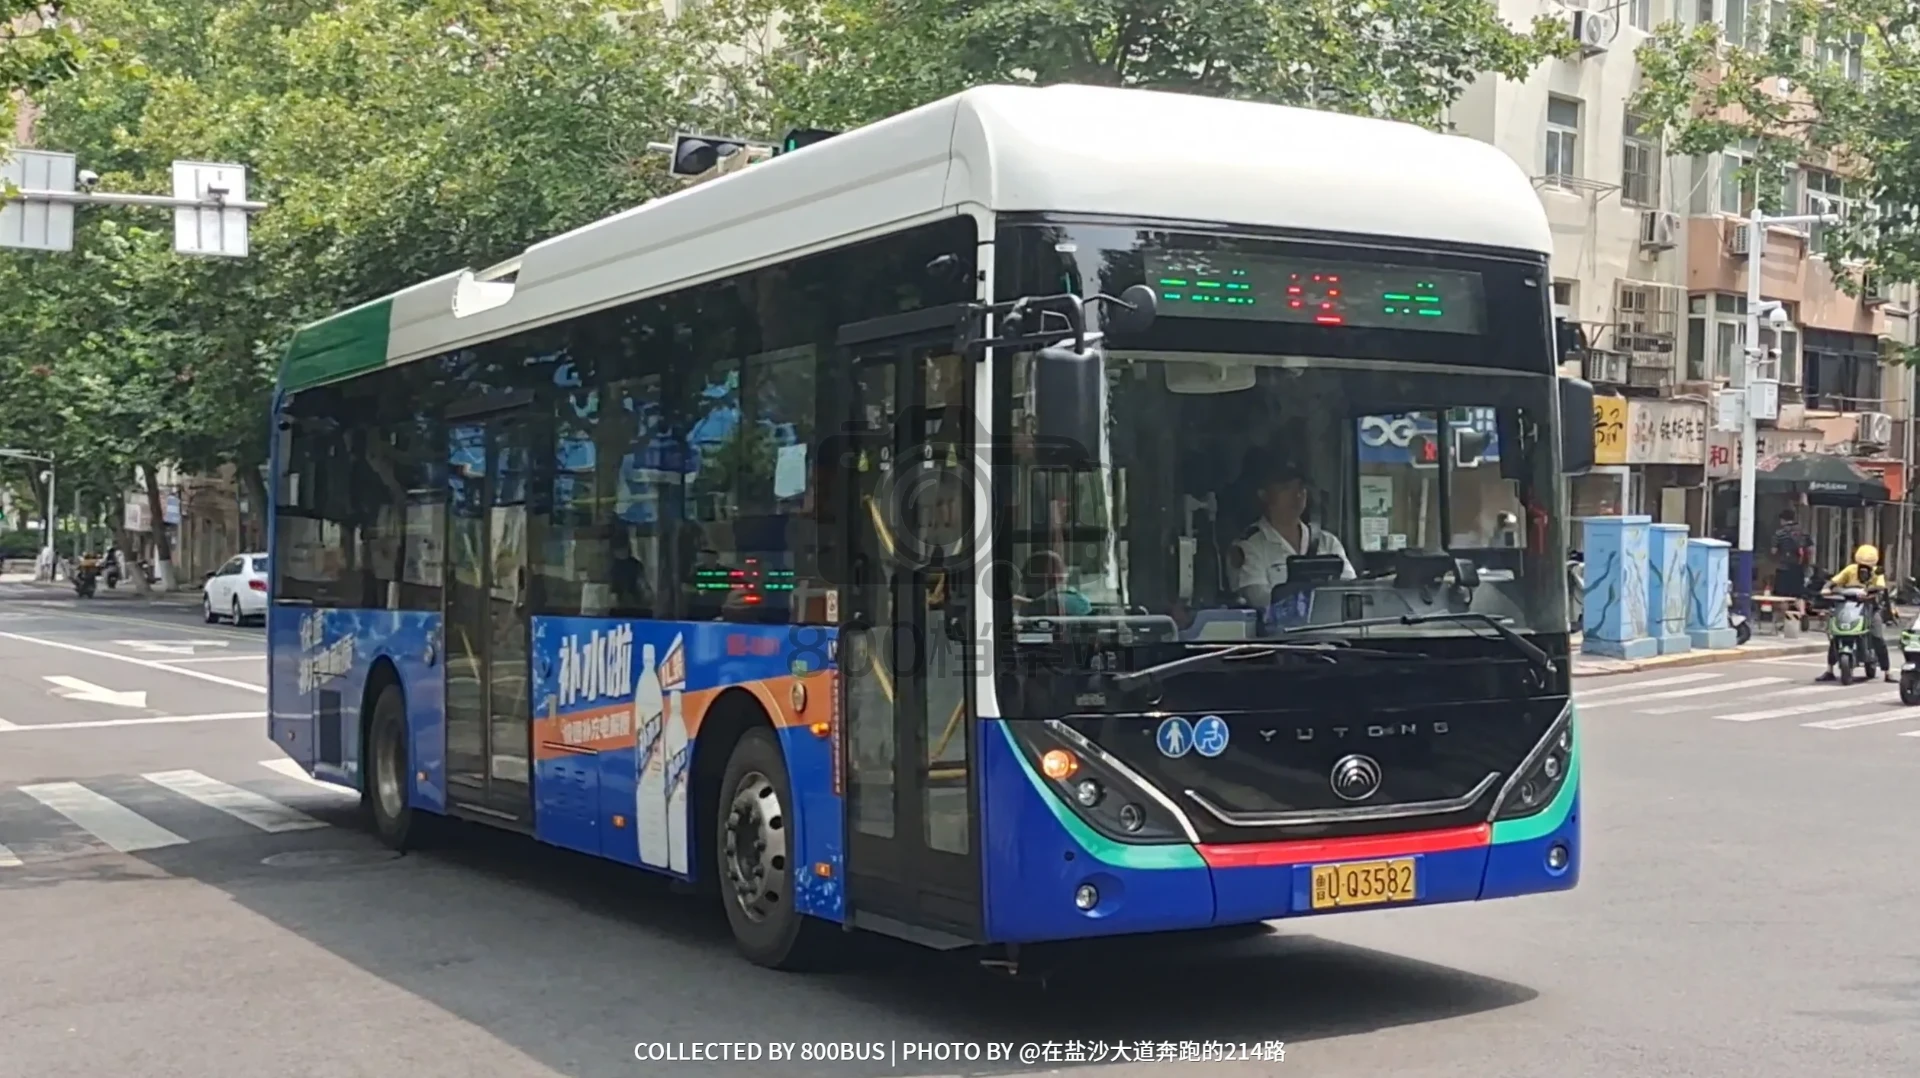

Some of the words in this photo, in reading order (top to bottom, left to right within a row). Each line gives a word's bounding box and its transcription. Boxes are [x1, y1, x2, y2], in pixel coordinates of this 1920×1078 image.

[557, 622, 633, 706] 补水啦
[1260, 721, 1449, 742] YUTONG
